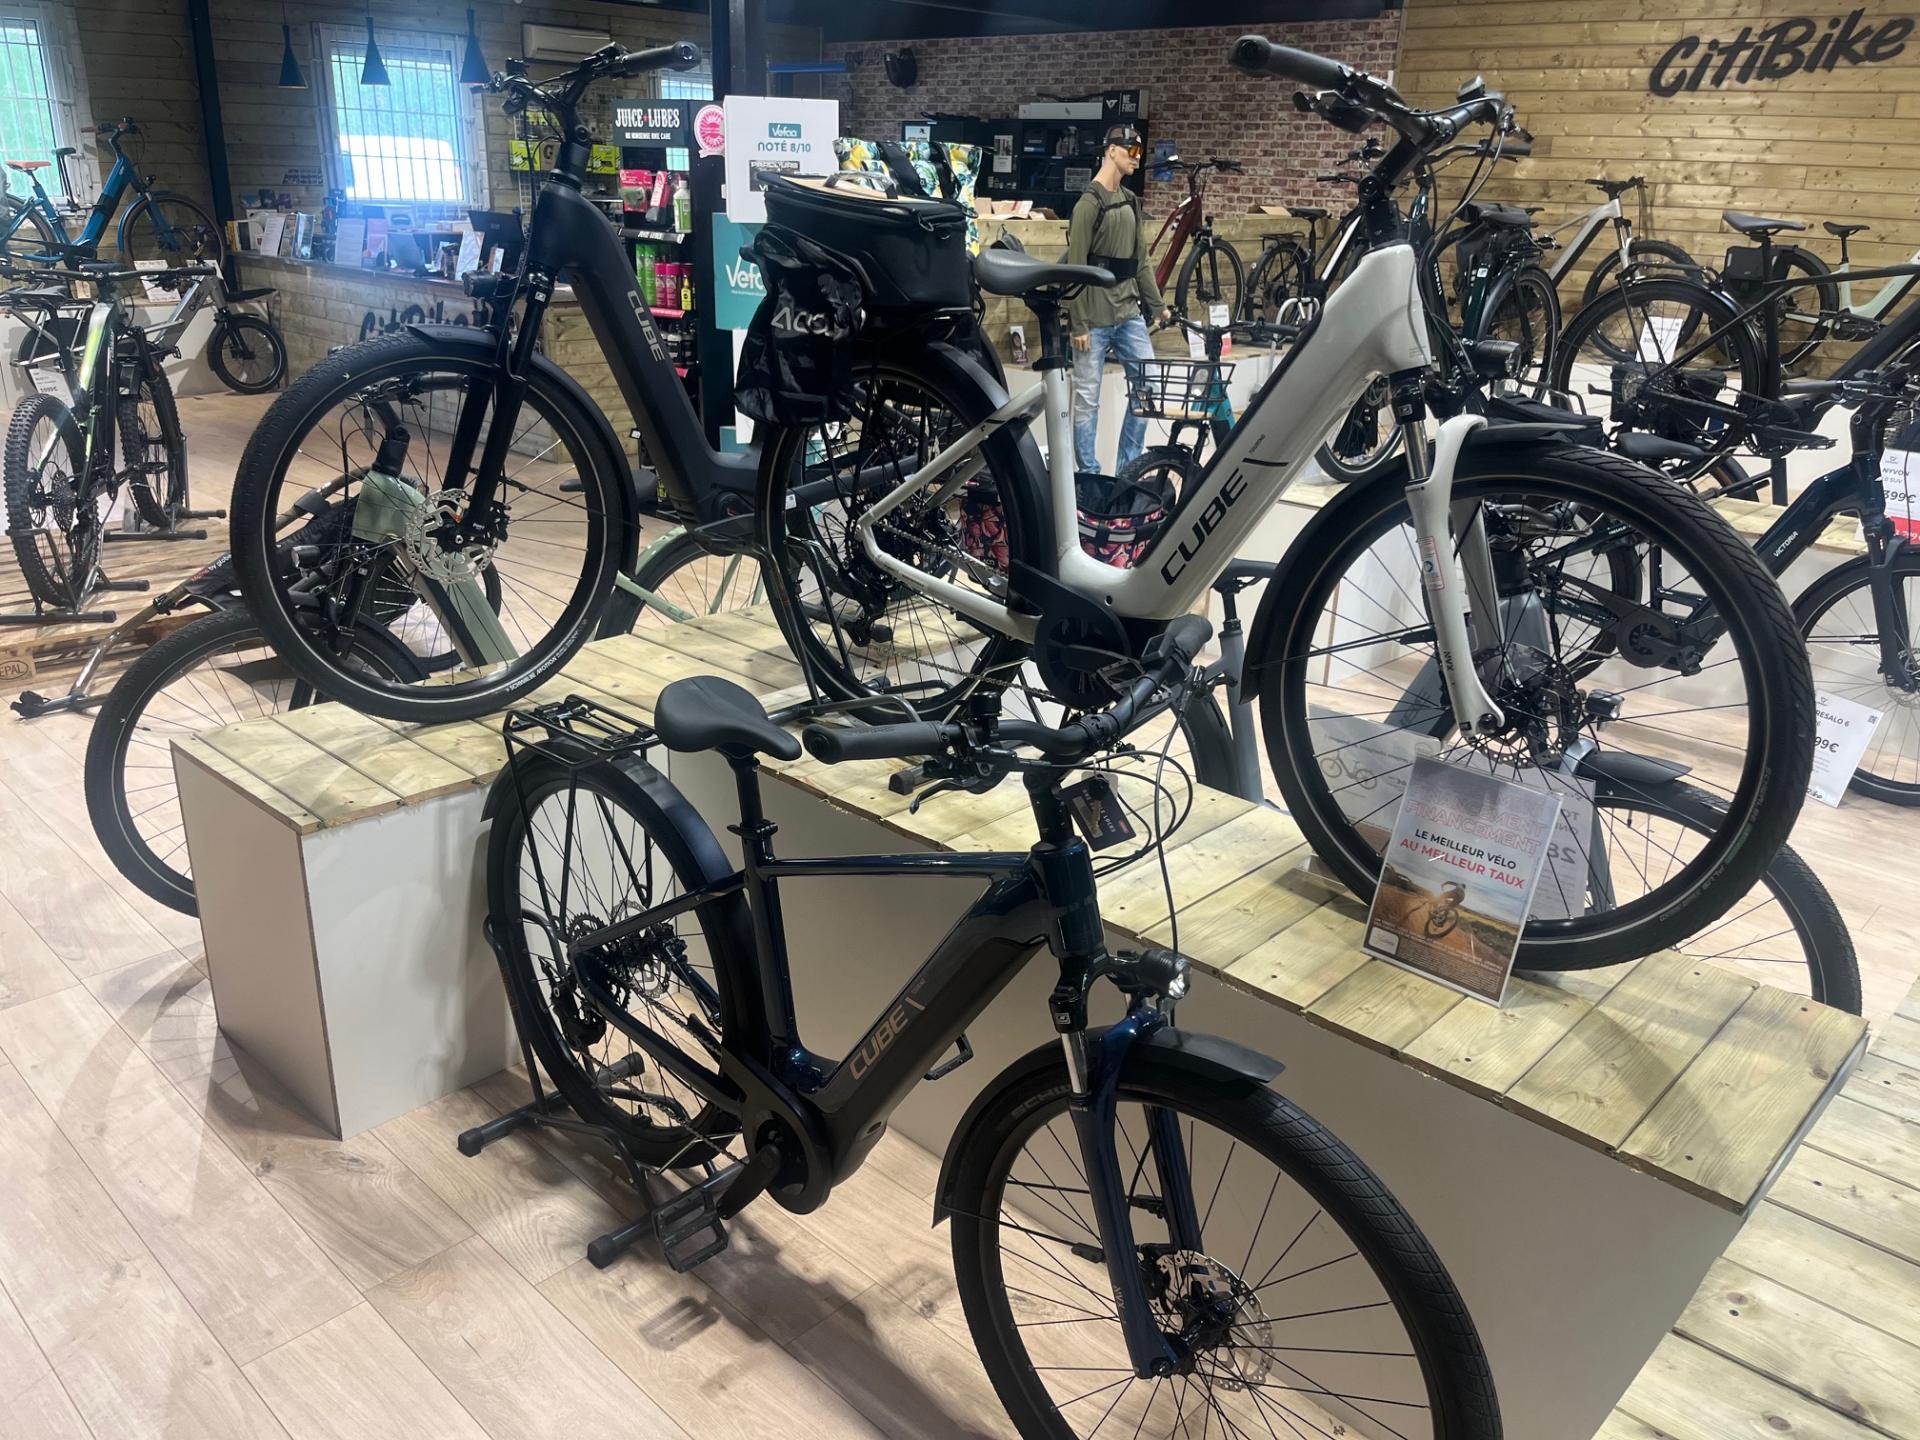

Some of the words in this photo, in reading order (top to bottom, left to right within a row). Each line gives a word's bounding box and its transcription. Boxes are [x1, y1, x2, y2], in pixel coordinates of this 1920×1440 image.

[1649, 8, 1915, 97] CitiBike
[615, 108, 643, 128] JUICE
[648, 108, 680, 128] LUBES
[790, 143, 811, 153] 8/10
[627, 290, 666, 362] CUBE
[1161, 467, 1248, 586] CUBE
[1773, 531, 1798, 557] VICTORIA
[1815, 710, 1844, 725] RESALO
[1400, 838, 1418, 852] AU
[1421, 844, 1486, 875] MEILLEUR
[1489, 868, 1526, 889] TAUX
[1415, 828, 1427, 840] LE
[1431, 833, 1485, 858] MEILLEUR
[1488, 851, 1516, 869] VÉLO
[849, 1004, 908, 1080] CUBE
